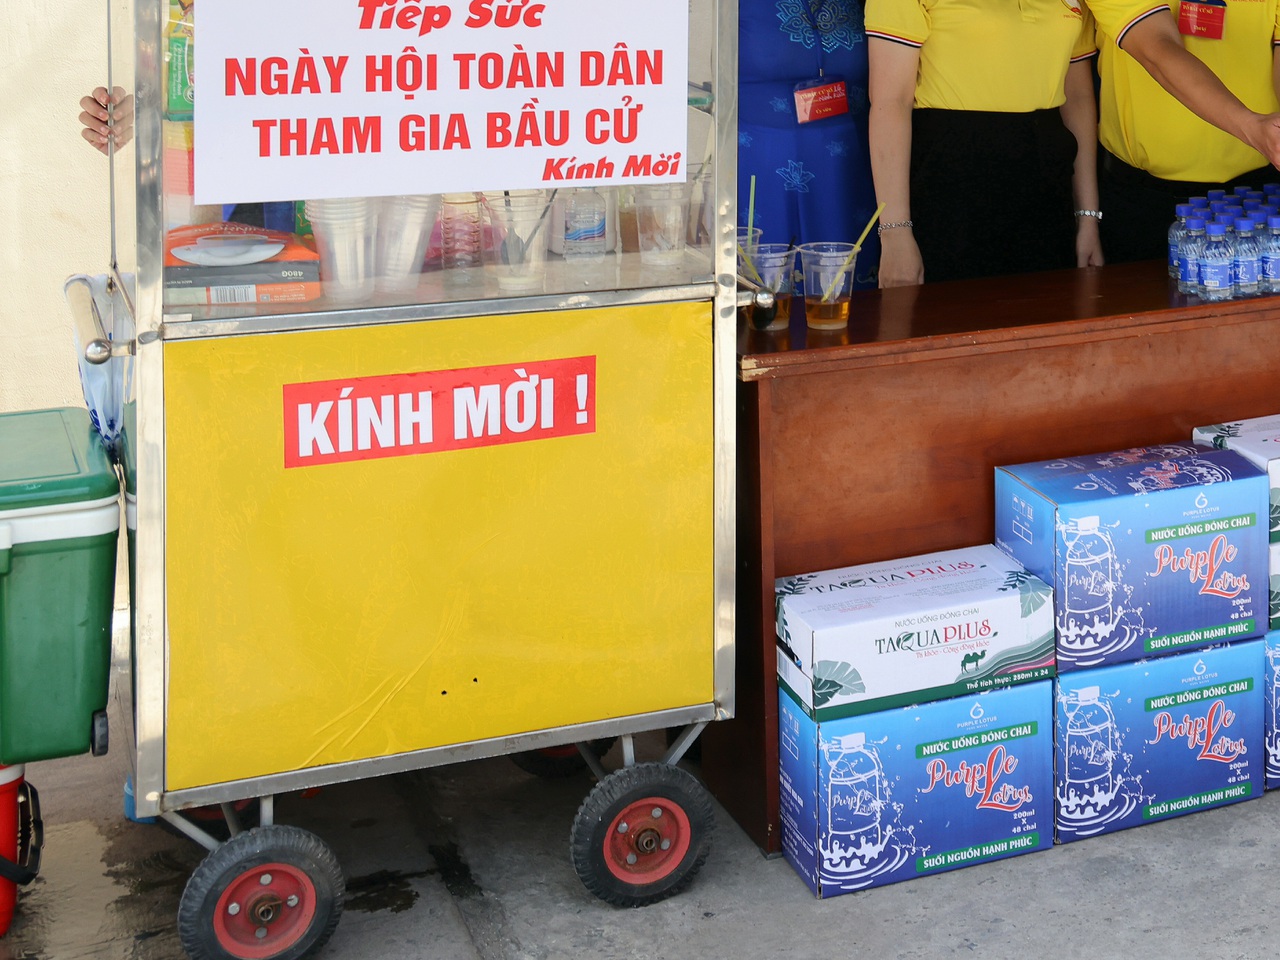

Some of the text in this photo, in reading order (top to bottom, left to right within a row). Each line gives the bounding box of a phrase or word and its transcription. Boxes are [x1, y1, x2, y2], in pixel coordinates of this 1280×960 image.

[224, 48, 348, 96] NGÀY
[366, 46, 437, 100] HỘI
[453, 44, 566, 90] TOÀN
[579, 42, 664, 87] DÂN
[253, 95, 643, 158] THAM GIA BẦU CỬ
[542, 152, 681, 182] Kính Mời
[298, 387, 433, 458] KÍNH
[454, 369, 554, 440] MỜI
[1151, 517, 1250, 540] NƯỚC UỐNG ĐÓNG CHAI
[1232, 597, 1251, 606] 200ml
[1151, 635, 1170, 649] SUỐI
[1204, 629, 1226, 640] HẠNH
[967, 681, 978, 689] Thể
[980, 679, 993, 687] tích
[1151, 682, 1248, 709] NƯỚC UỐNG ĐÓNG CHAI
[923, 725, 1032, 755] NƯỚC UỐNG ĐÓNG CHAI
[1229, 761, 1248, 770] 200ml
[1013, 809, 1035, 819] 200ml
[1149, 801, 1169, 816] SUỐI
[1201, 792, 1224, 806] HẠNH
[1012, 826, 1021, 834] 48
[924, 853, 945, 869] SUỐI
[983, 843, 1007, 857] HẠNH
